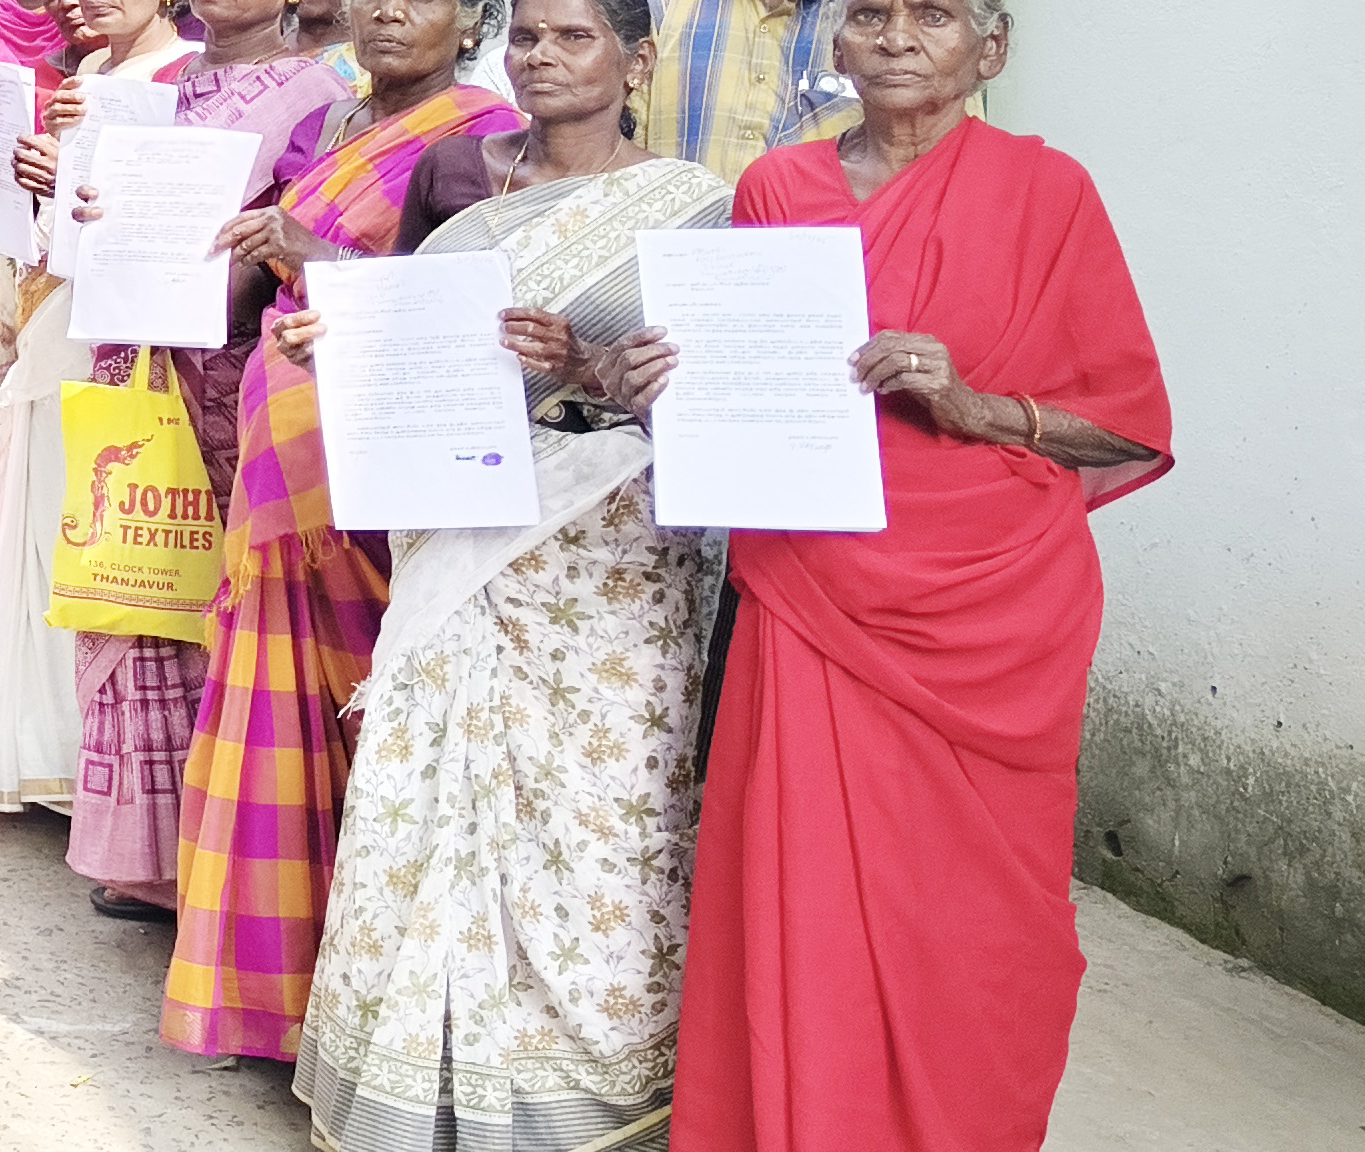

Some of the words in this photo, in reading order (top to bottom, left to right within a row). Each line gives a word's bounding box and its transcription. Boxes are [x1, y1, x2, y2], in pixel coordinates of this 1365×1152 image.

[118, 482, 216, 523] JOTHI
[119, 523, 214, 551] TEXTILES
[110, 562, 145, 574] CLOCK
[91, 572, 178, 592] THANJAVUR.
